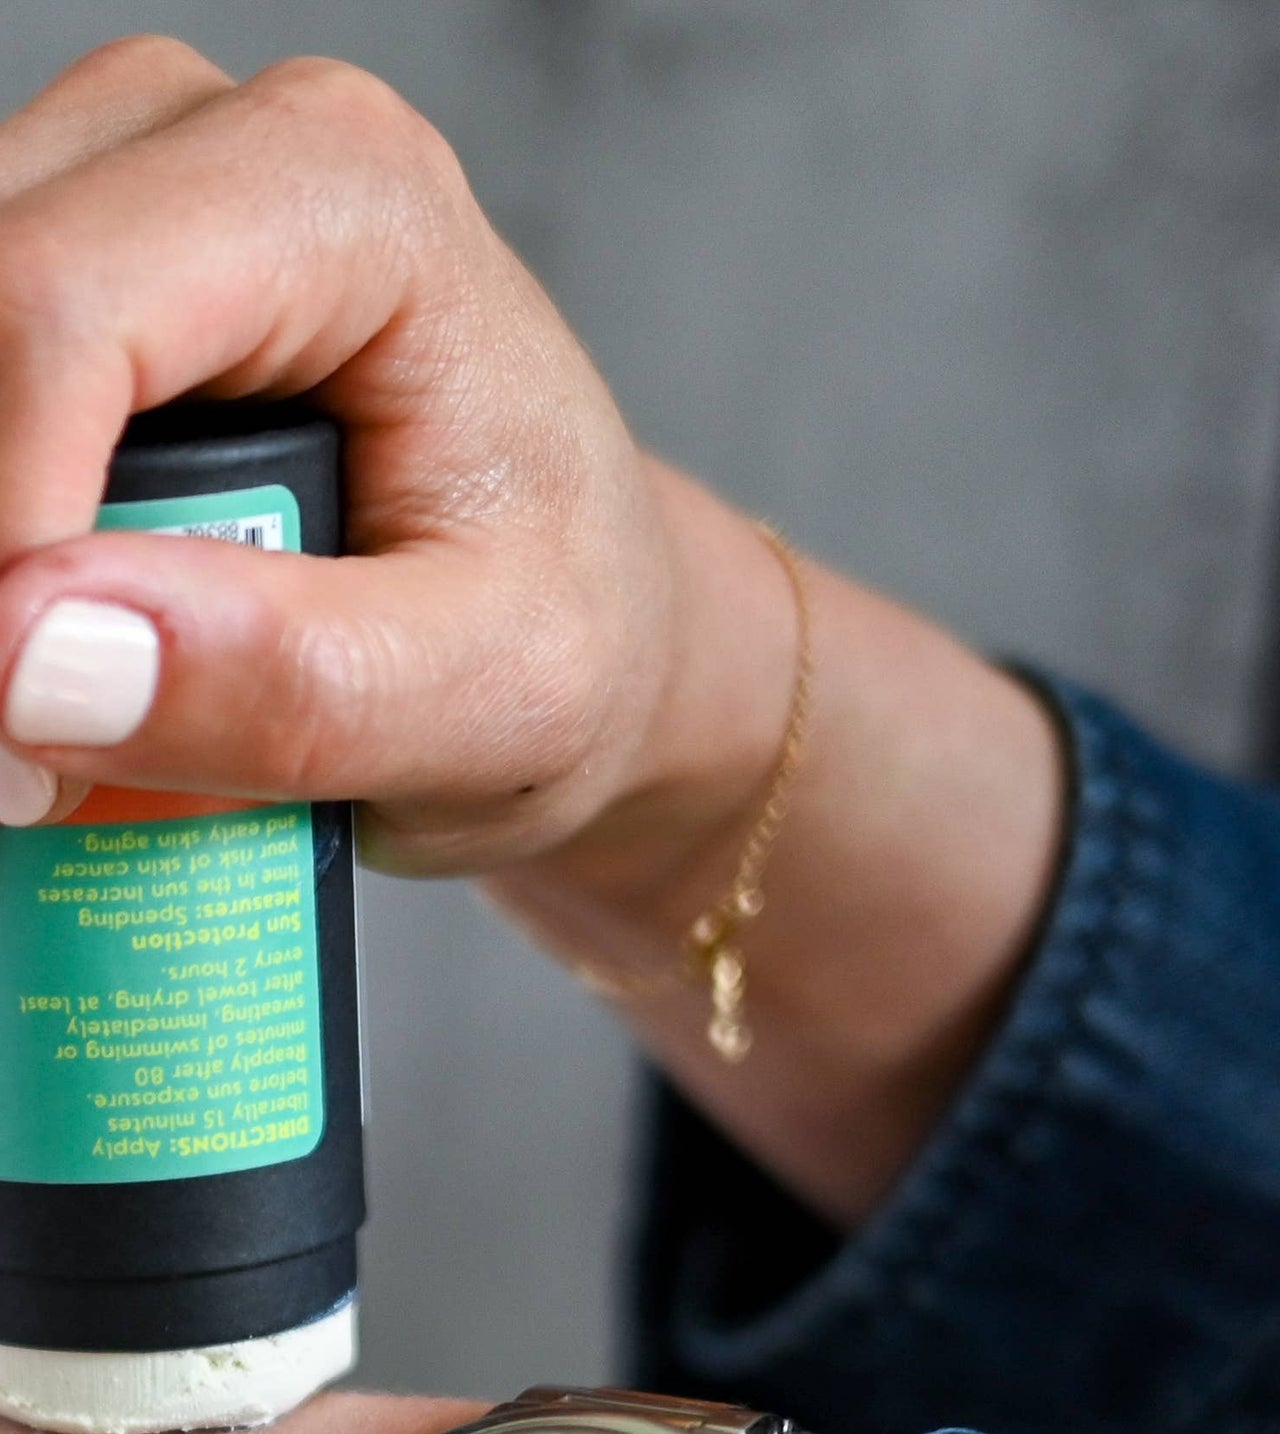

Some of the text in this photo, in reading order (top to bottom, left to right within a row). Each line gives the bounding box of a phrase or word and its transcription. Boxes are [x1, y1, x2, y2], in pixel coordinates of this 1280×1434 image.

[78, 814, 297, 854] and early skin aging.
[52, 836, 298, 878] your risk of skin cancer
[38, 886, 144, 904] increases
[152, 880, 188, 899] sun
[198, 877, 231, 897] the
[238, 873, 254, 890] in
[78, 889, 300, 930] Measures: Spending
[132, 912, 301, 953] Sun Protection
[160, 946, 302, 982] every 2 hours.
[20, 971, 302, 1014] after towel drying, at least
[66, 996, 304, 1038] sweating, immediately
[55, 1020, 304, 1063] minutes of swimming or
[134, 1044, 306, 1087] Reapply after 80
[86, 1067, 307, 1108] before sun exposure.
[107, 1092, 308, 1132] liberally 15 minutes
[91, 1115, 310, 1160] DIRECTIONS: Apply
